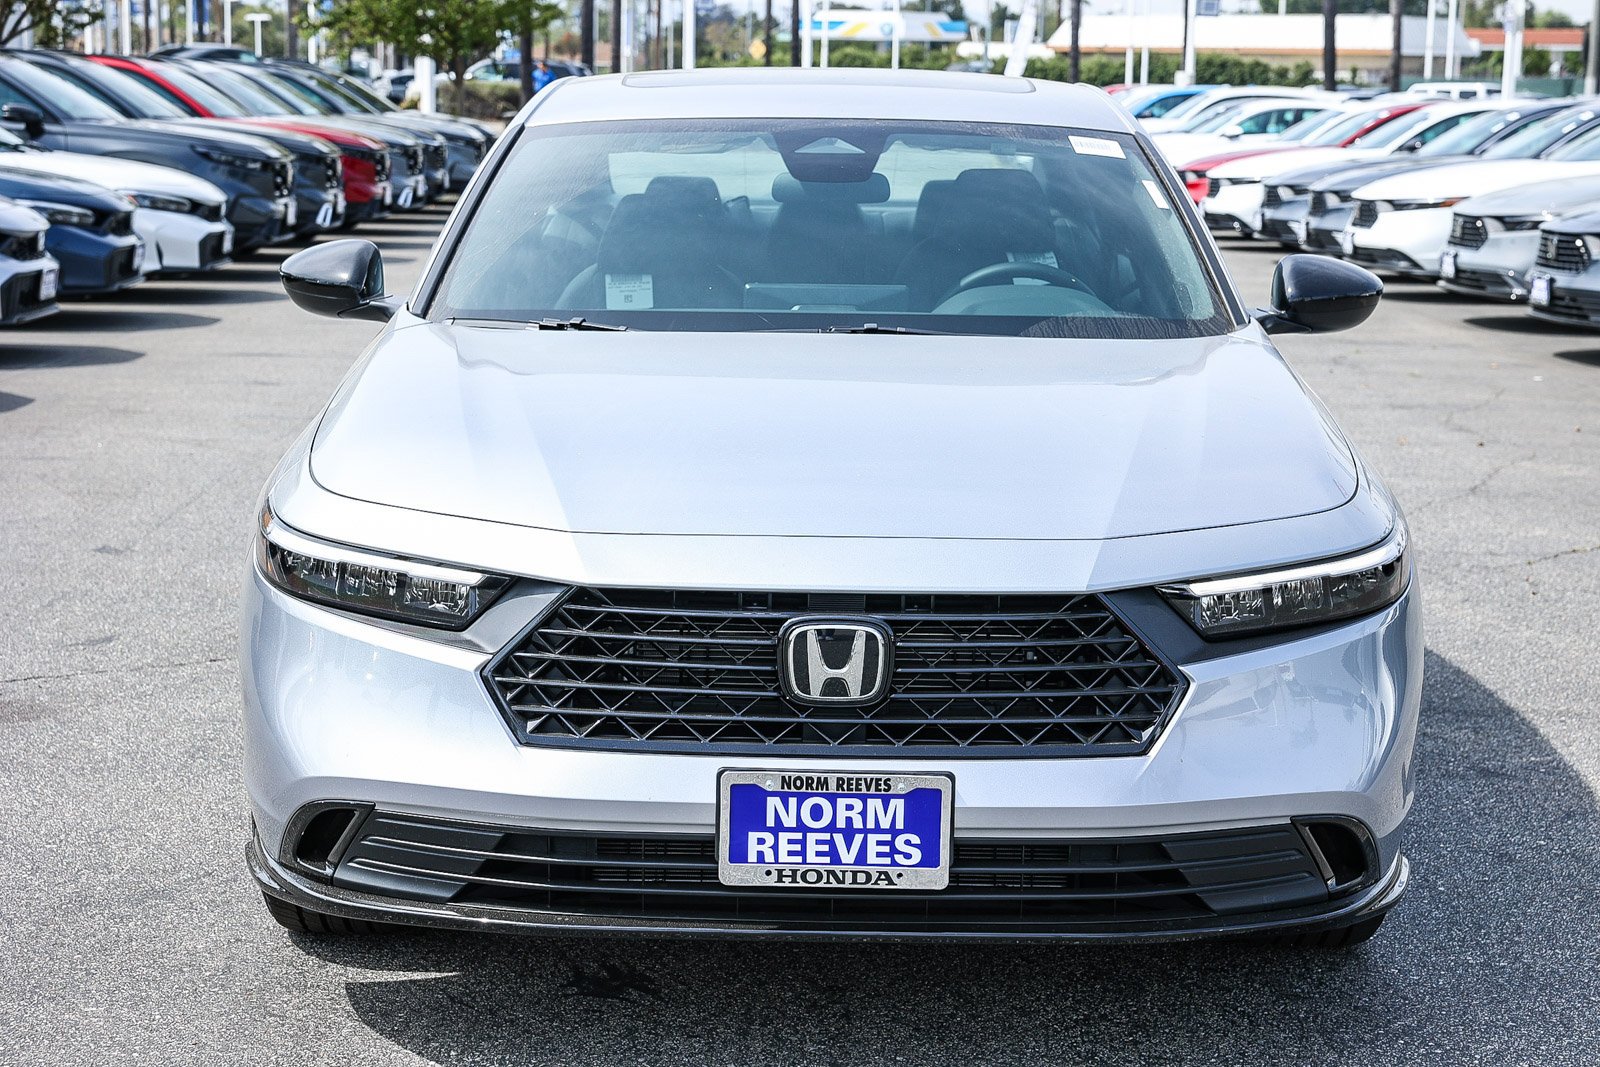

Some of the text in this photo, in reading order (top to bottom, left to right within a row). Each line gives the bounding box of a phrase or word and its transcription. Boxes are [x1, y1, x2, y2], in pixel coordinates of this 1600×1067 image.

[780, 775, 892, 792] NORM REEVES
[766, 796, 905, 830] NORM
[747, 831, 922, 866] REEVES
[774, 868, 898, 886] HONDA
